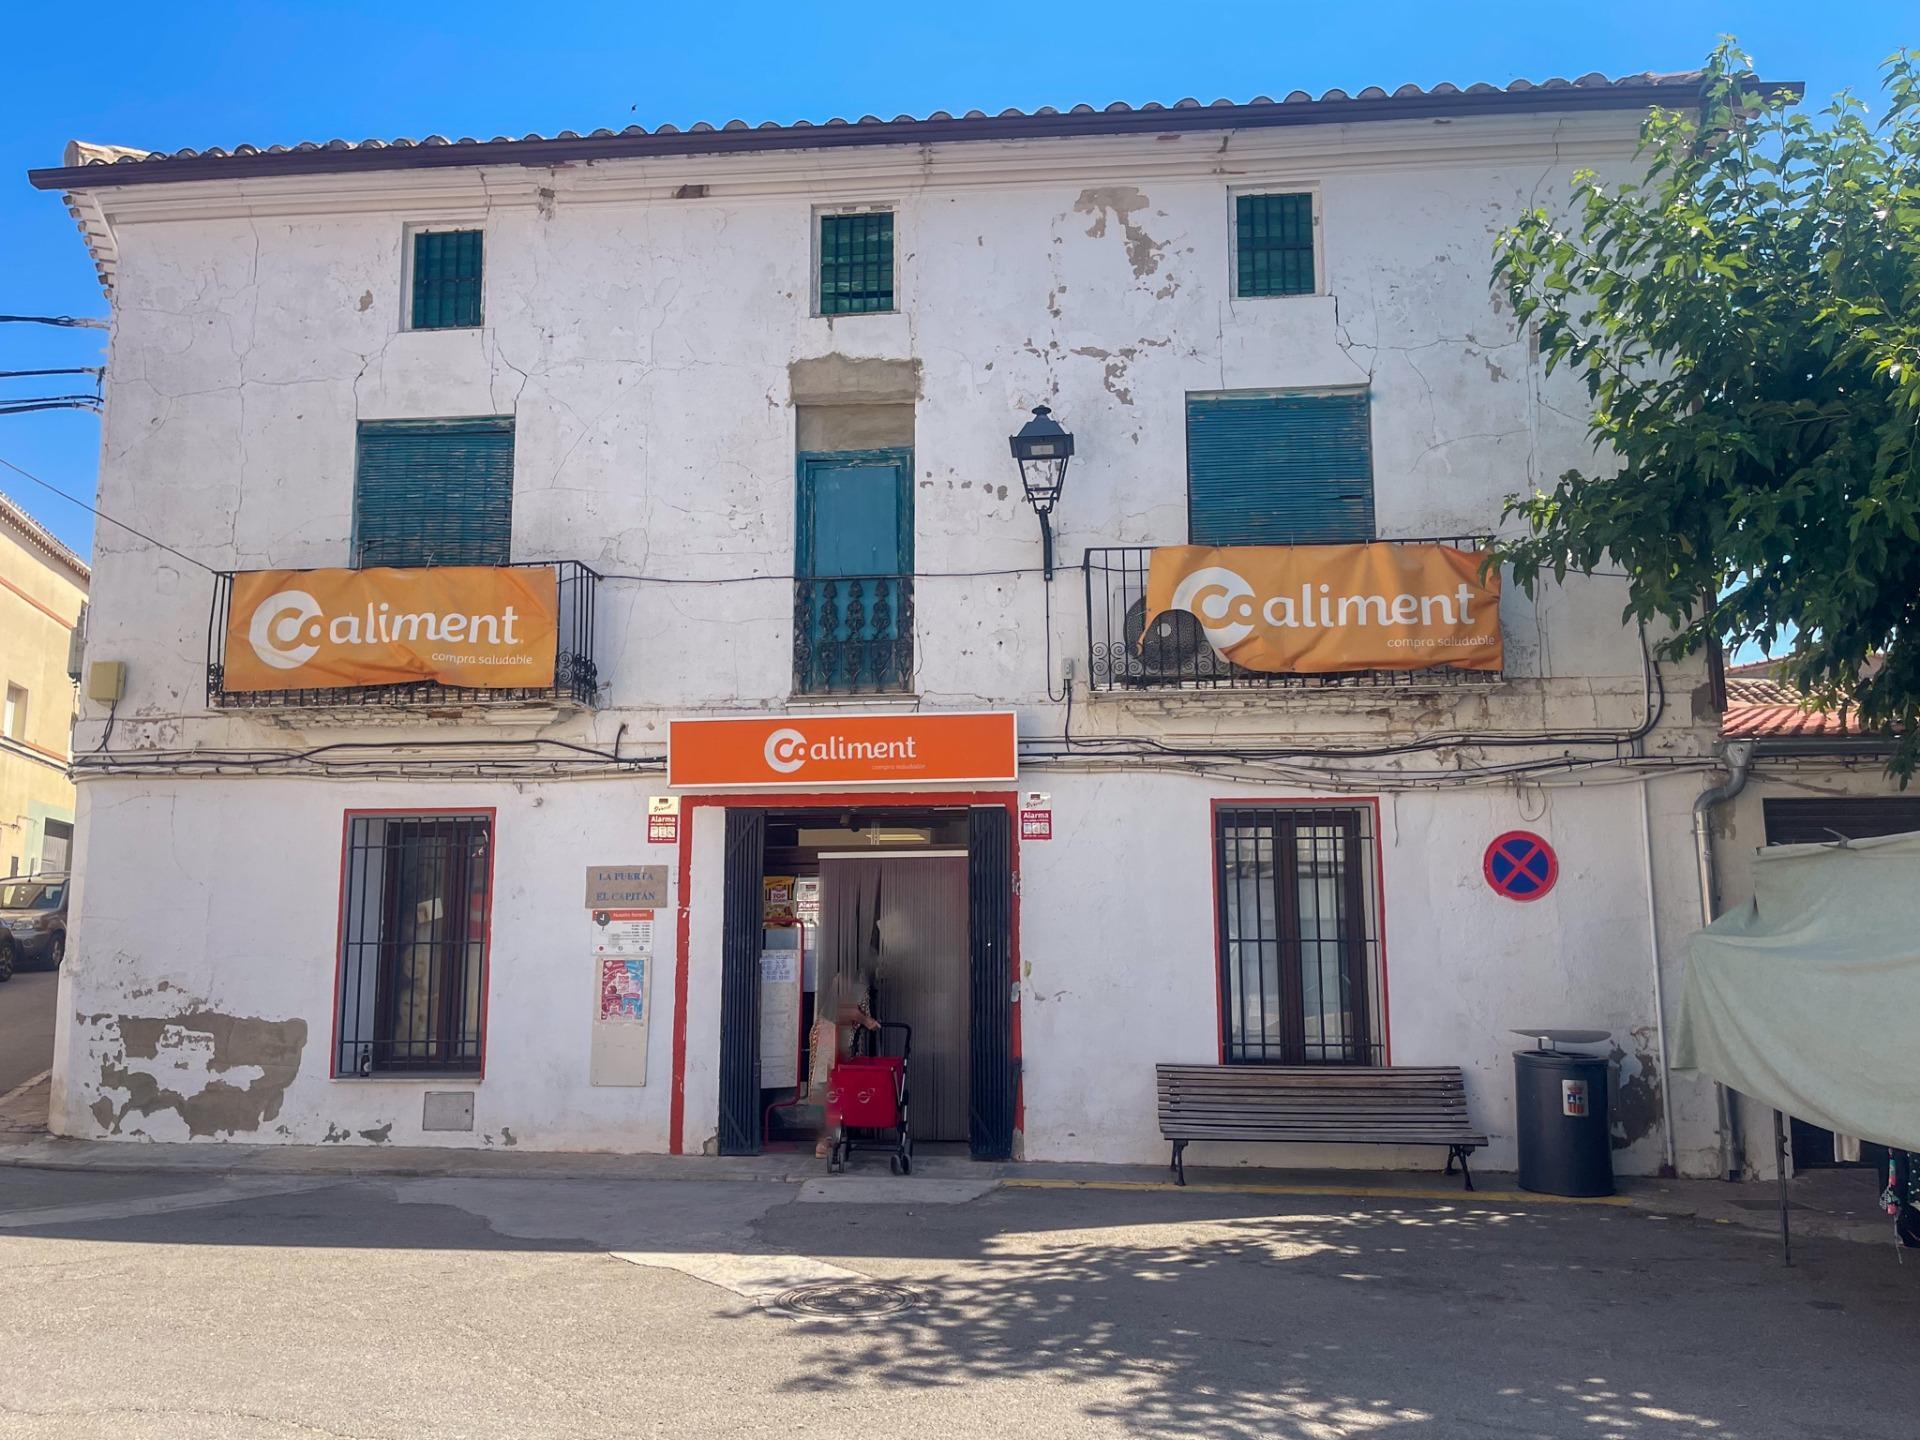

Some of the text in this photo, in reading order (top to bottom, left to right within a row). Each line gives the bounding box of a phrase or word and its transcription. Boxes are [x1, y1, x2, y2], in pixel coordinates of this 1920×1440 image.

[1387, 634, 1495, 649] compra saludable
[431, 651, 533, 665] compra saludable
[599, 872, 654, 881] LA PUERTA
